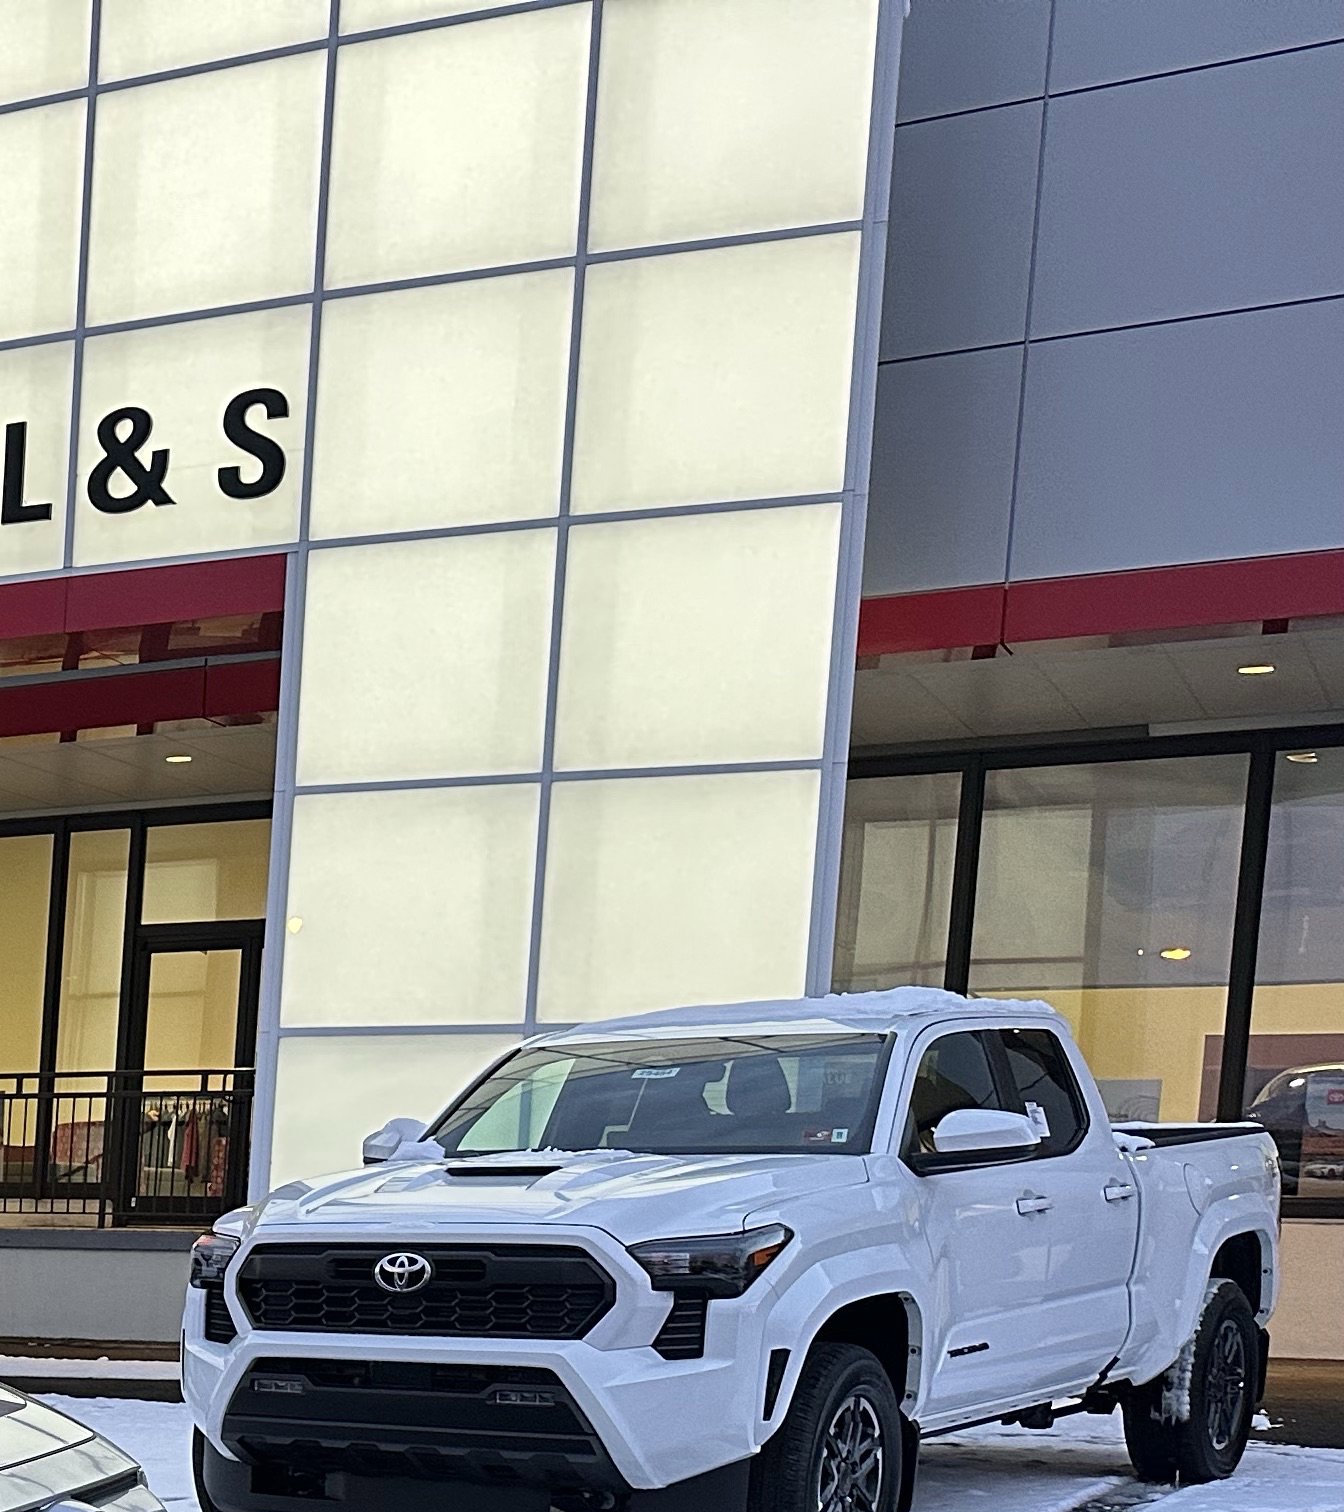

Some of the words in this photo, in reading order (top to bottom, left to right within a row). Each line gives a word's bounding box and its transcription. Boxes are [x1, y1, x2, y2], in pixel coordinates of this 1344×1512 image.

[1, 421, 53, 525] L
[86, 406, 178, 514] &
[217, 387, 291, 500] S
